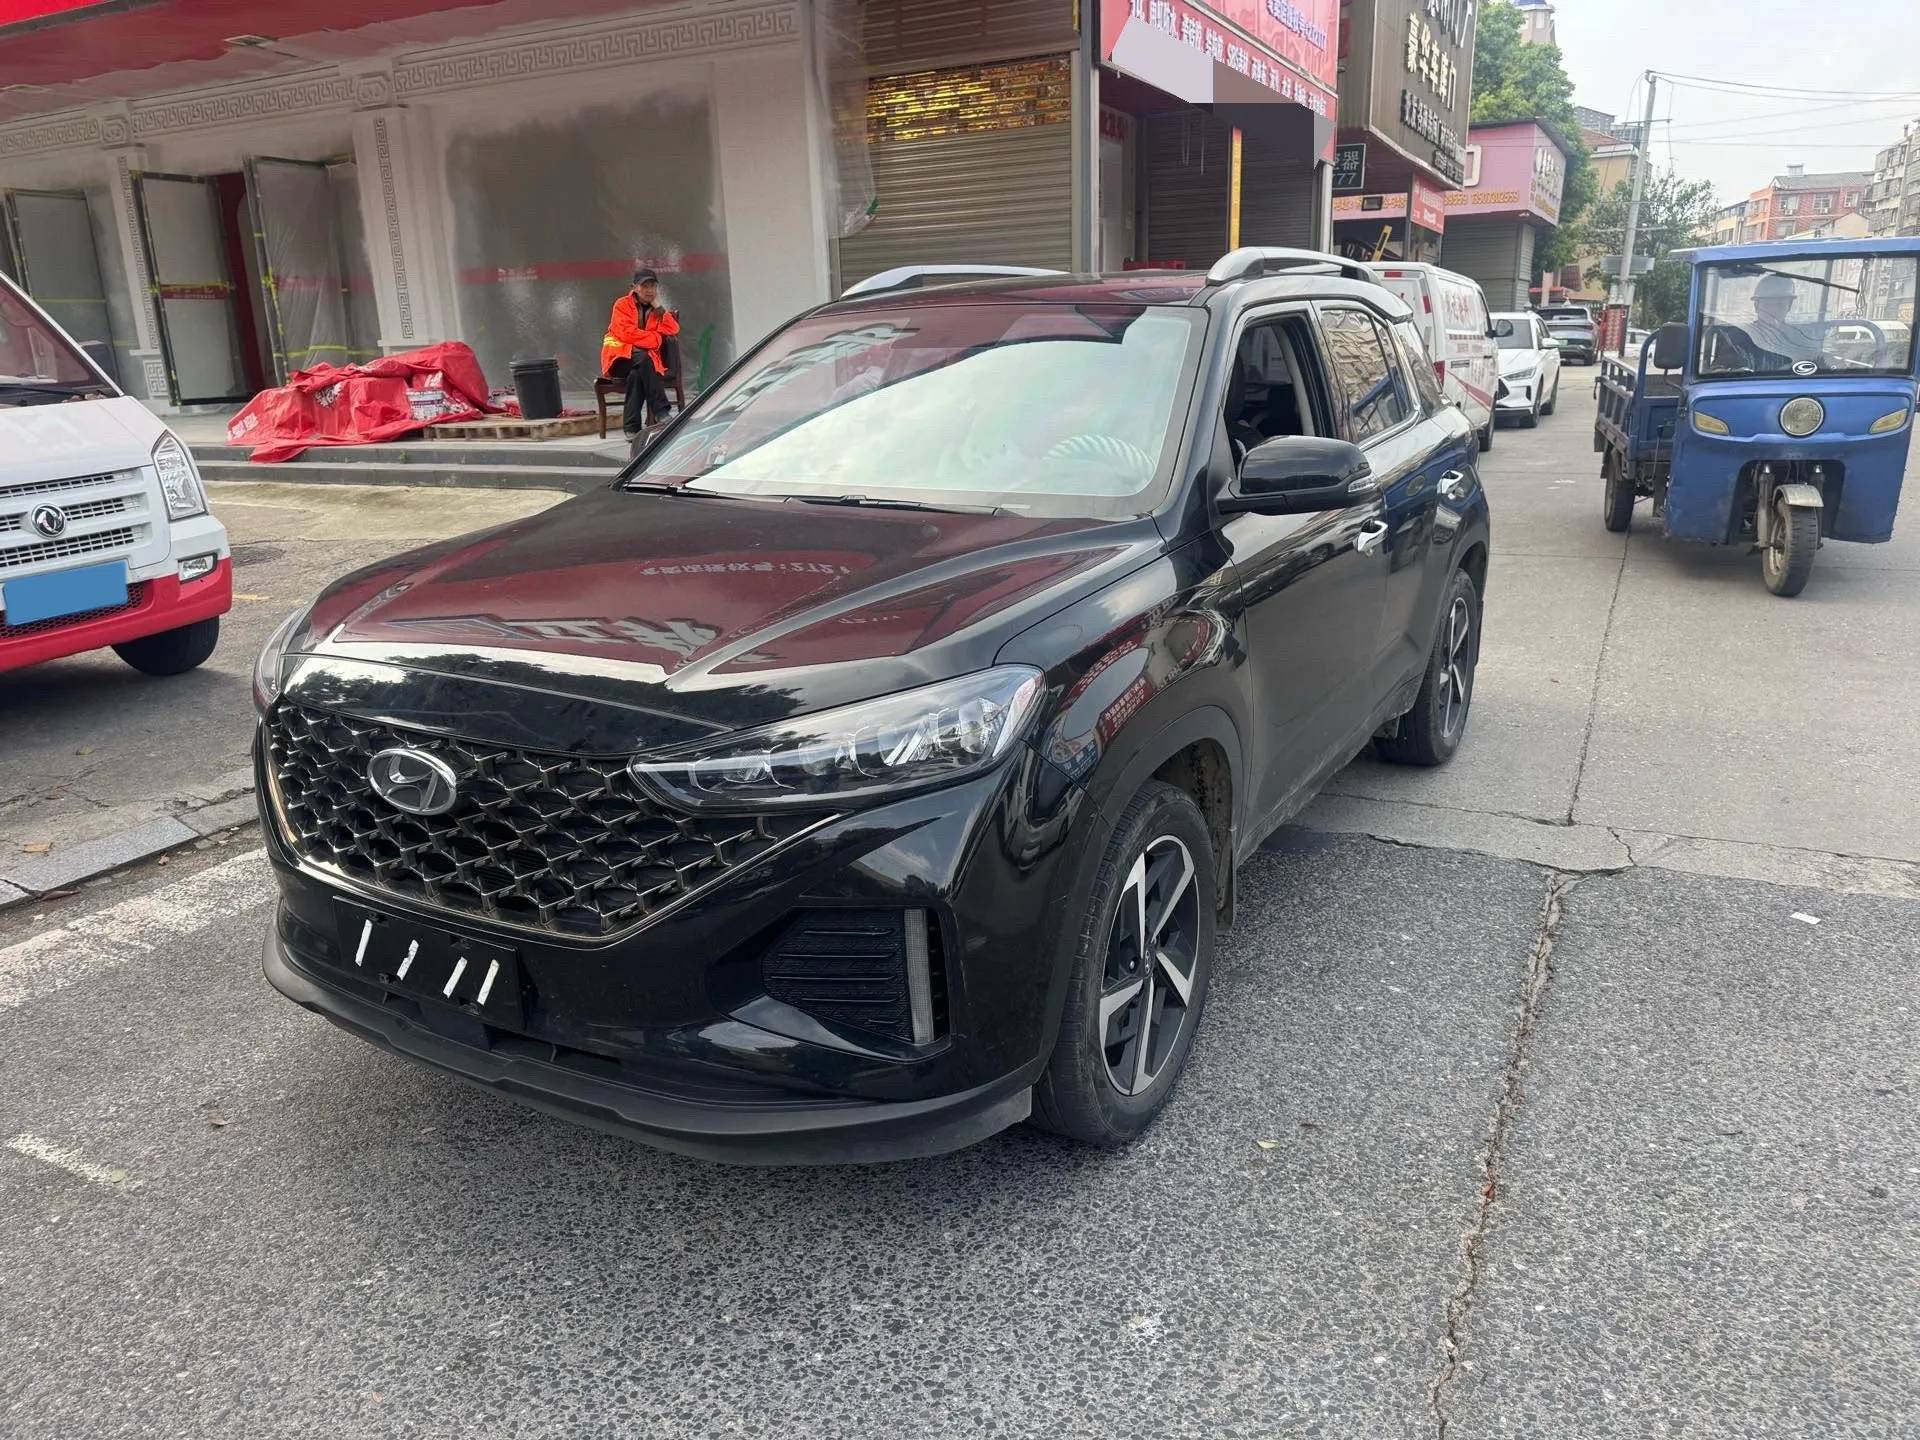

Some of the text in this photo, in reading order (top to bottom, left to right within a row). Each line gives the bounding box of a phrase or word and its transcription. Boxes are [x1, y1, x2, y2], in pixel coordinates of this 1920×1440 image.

[1407, 12, 1457, 112] 豪华车库门
[1333, 172, 1357, 185] 77
